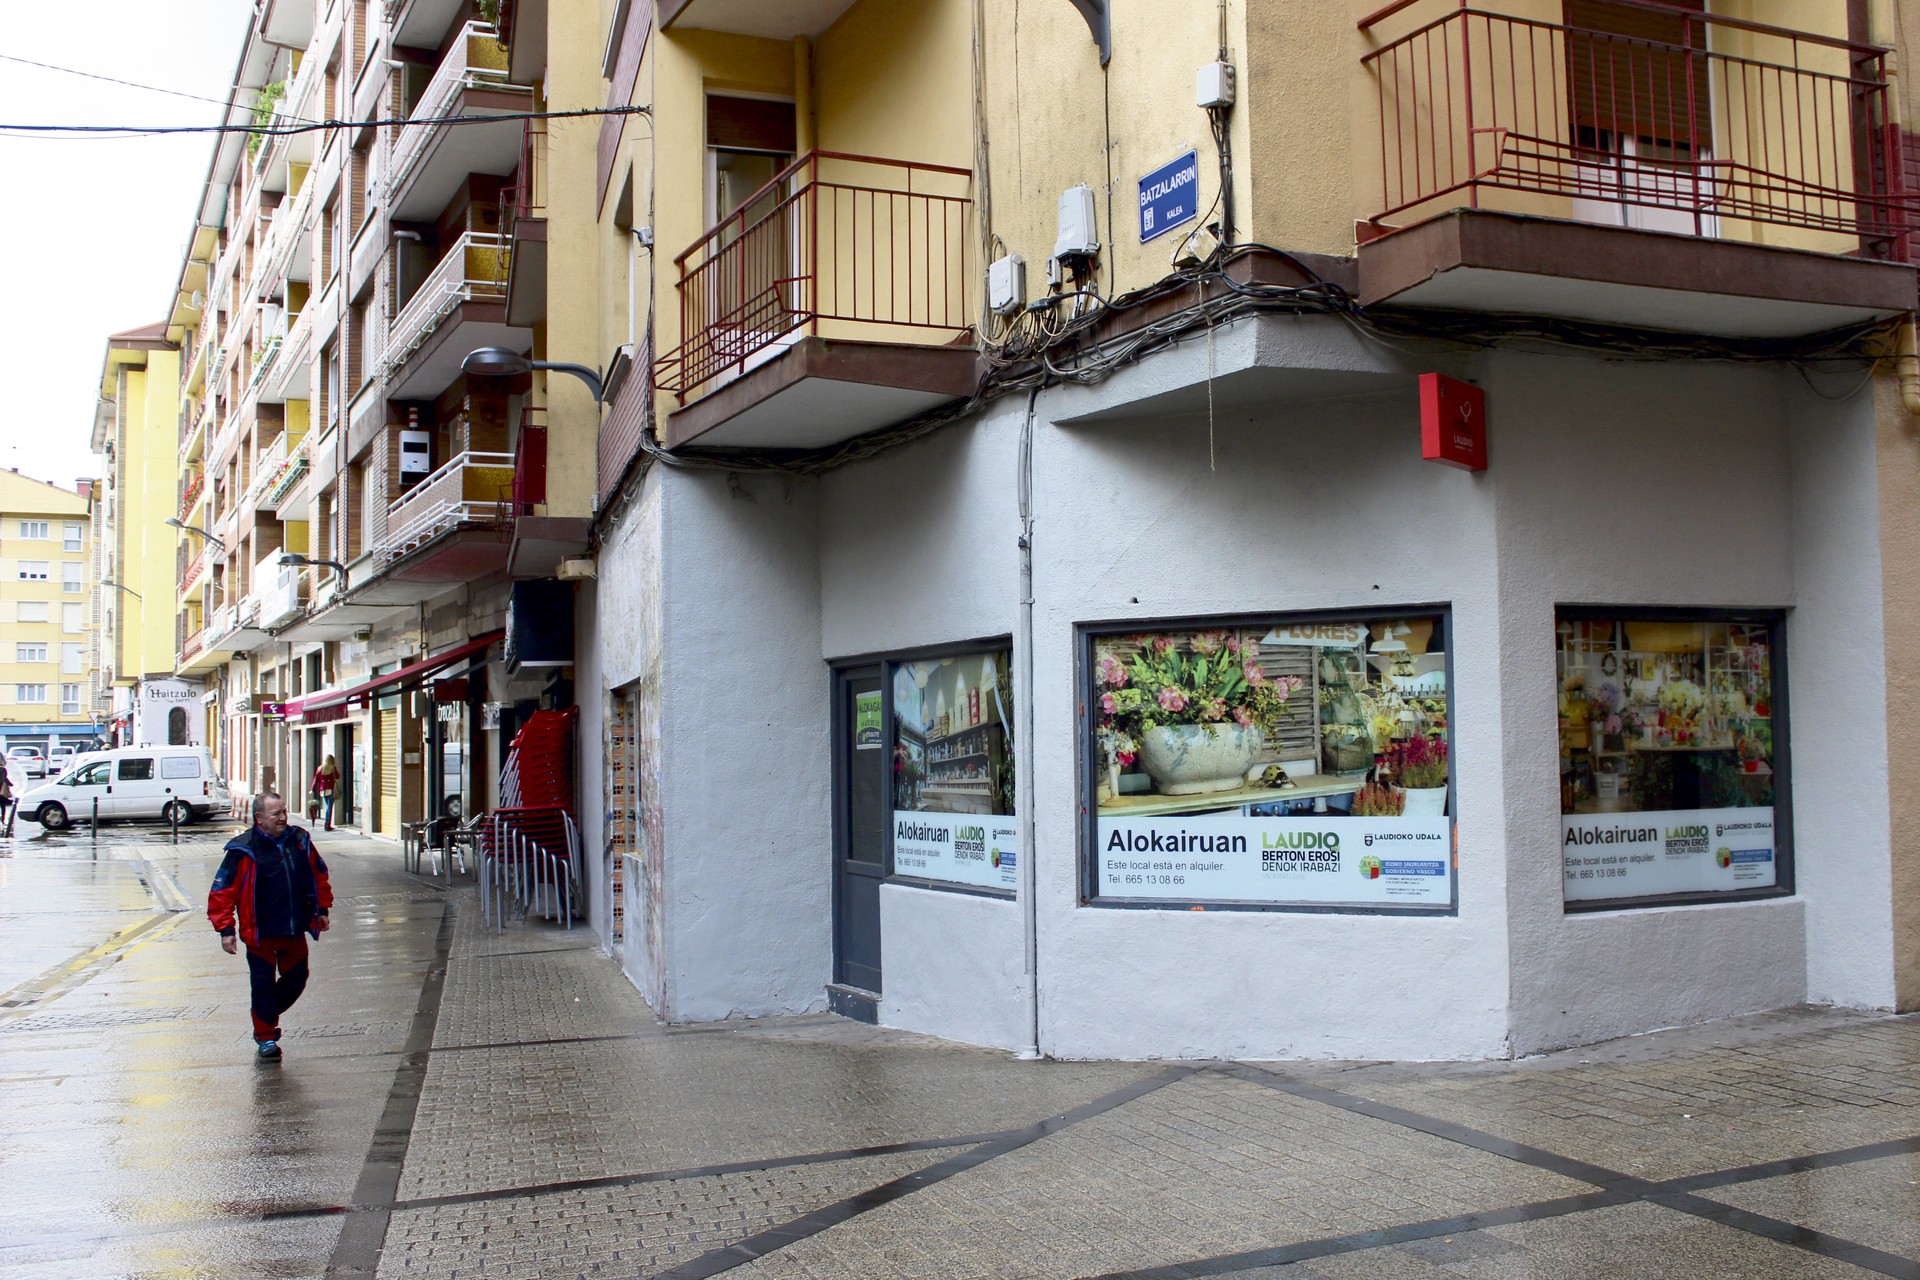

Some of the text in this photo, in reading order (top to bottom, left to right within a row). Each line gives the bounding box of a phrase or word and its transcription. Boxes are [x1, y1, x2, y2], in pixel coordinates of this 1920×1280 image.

[1141, 165, 1195, 206] BATZALARRIN
[1166, 205, 1183, 220] KALEA
[150, 689, 197, 698] Haitzulo
[897, 821, 949, 843] Alokairuan
[955, 825, 985, 841] LAUDIO
[1565, 826, 1657, 846] Alokairuan
[1665, 825, 1709, 840] LAUDIO
[1107, 829, 1247, 853] Alokairuan
[1262, 832, 1340, 851] LAUDIO
[1262, 850, 1340, 862] BERTON EROSI
[1565, 857, 1581, 866] Este
[1583, 856, 1600, 866] local
[1602, 855, 1617, 864] está
[1107, 860, 1225, 872] Este local está en alquiler.
[1262, 861, 1341, 873] DENOK IRABAZI
[1565, 868, 1627, 879] Tel. 665 13 08 66
[1108, 874, 1185, 885] Tel. 665 13 08 66
